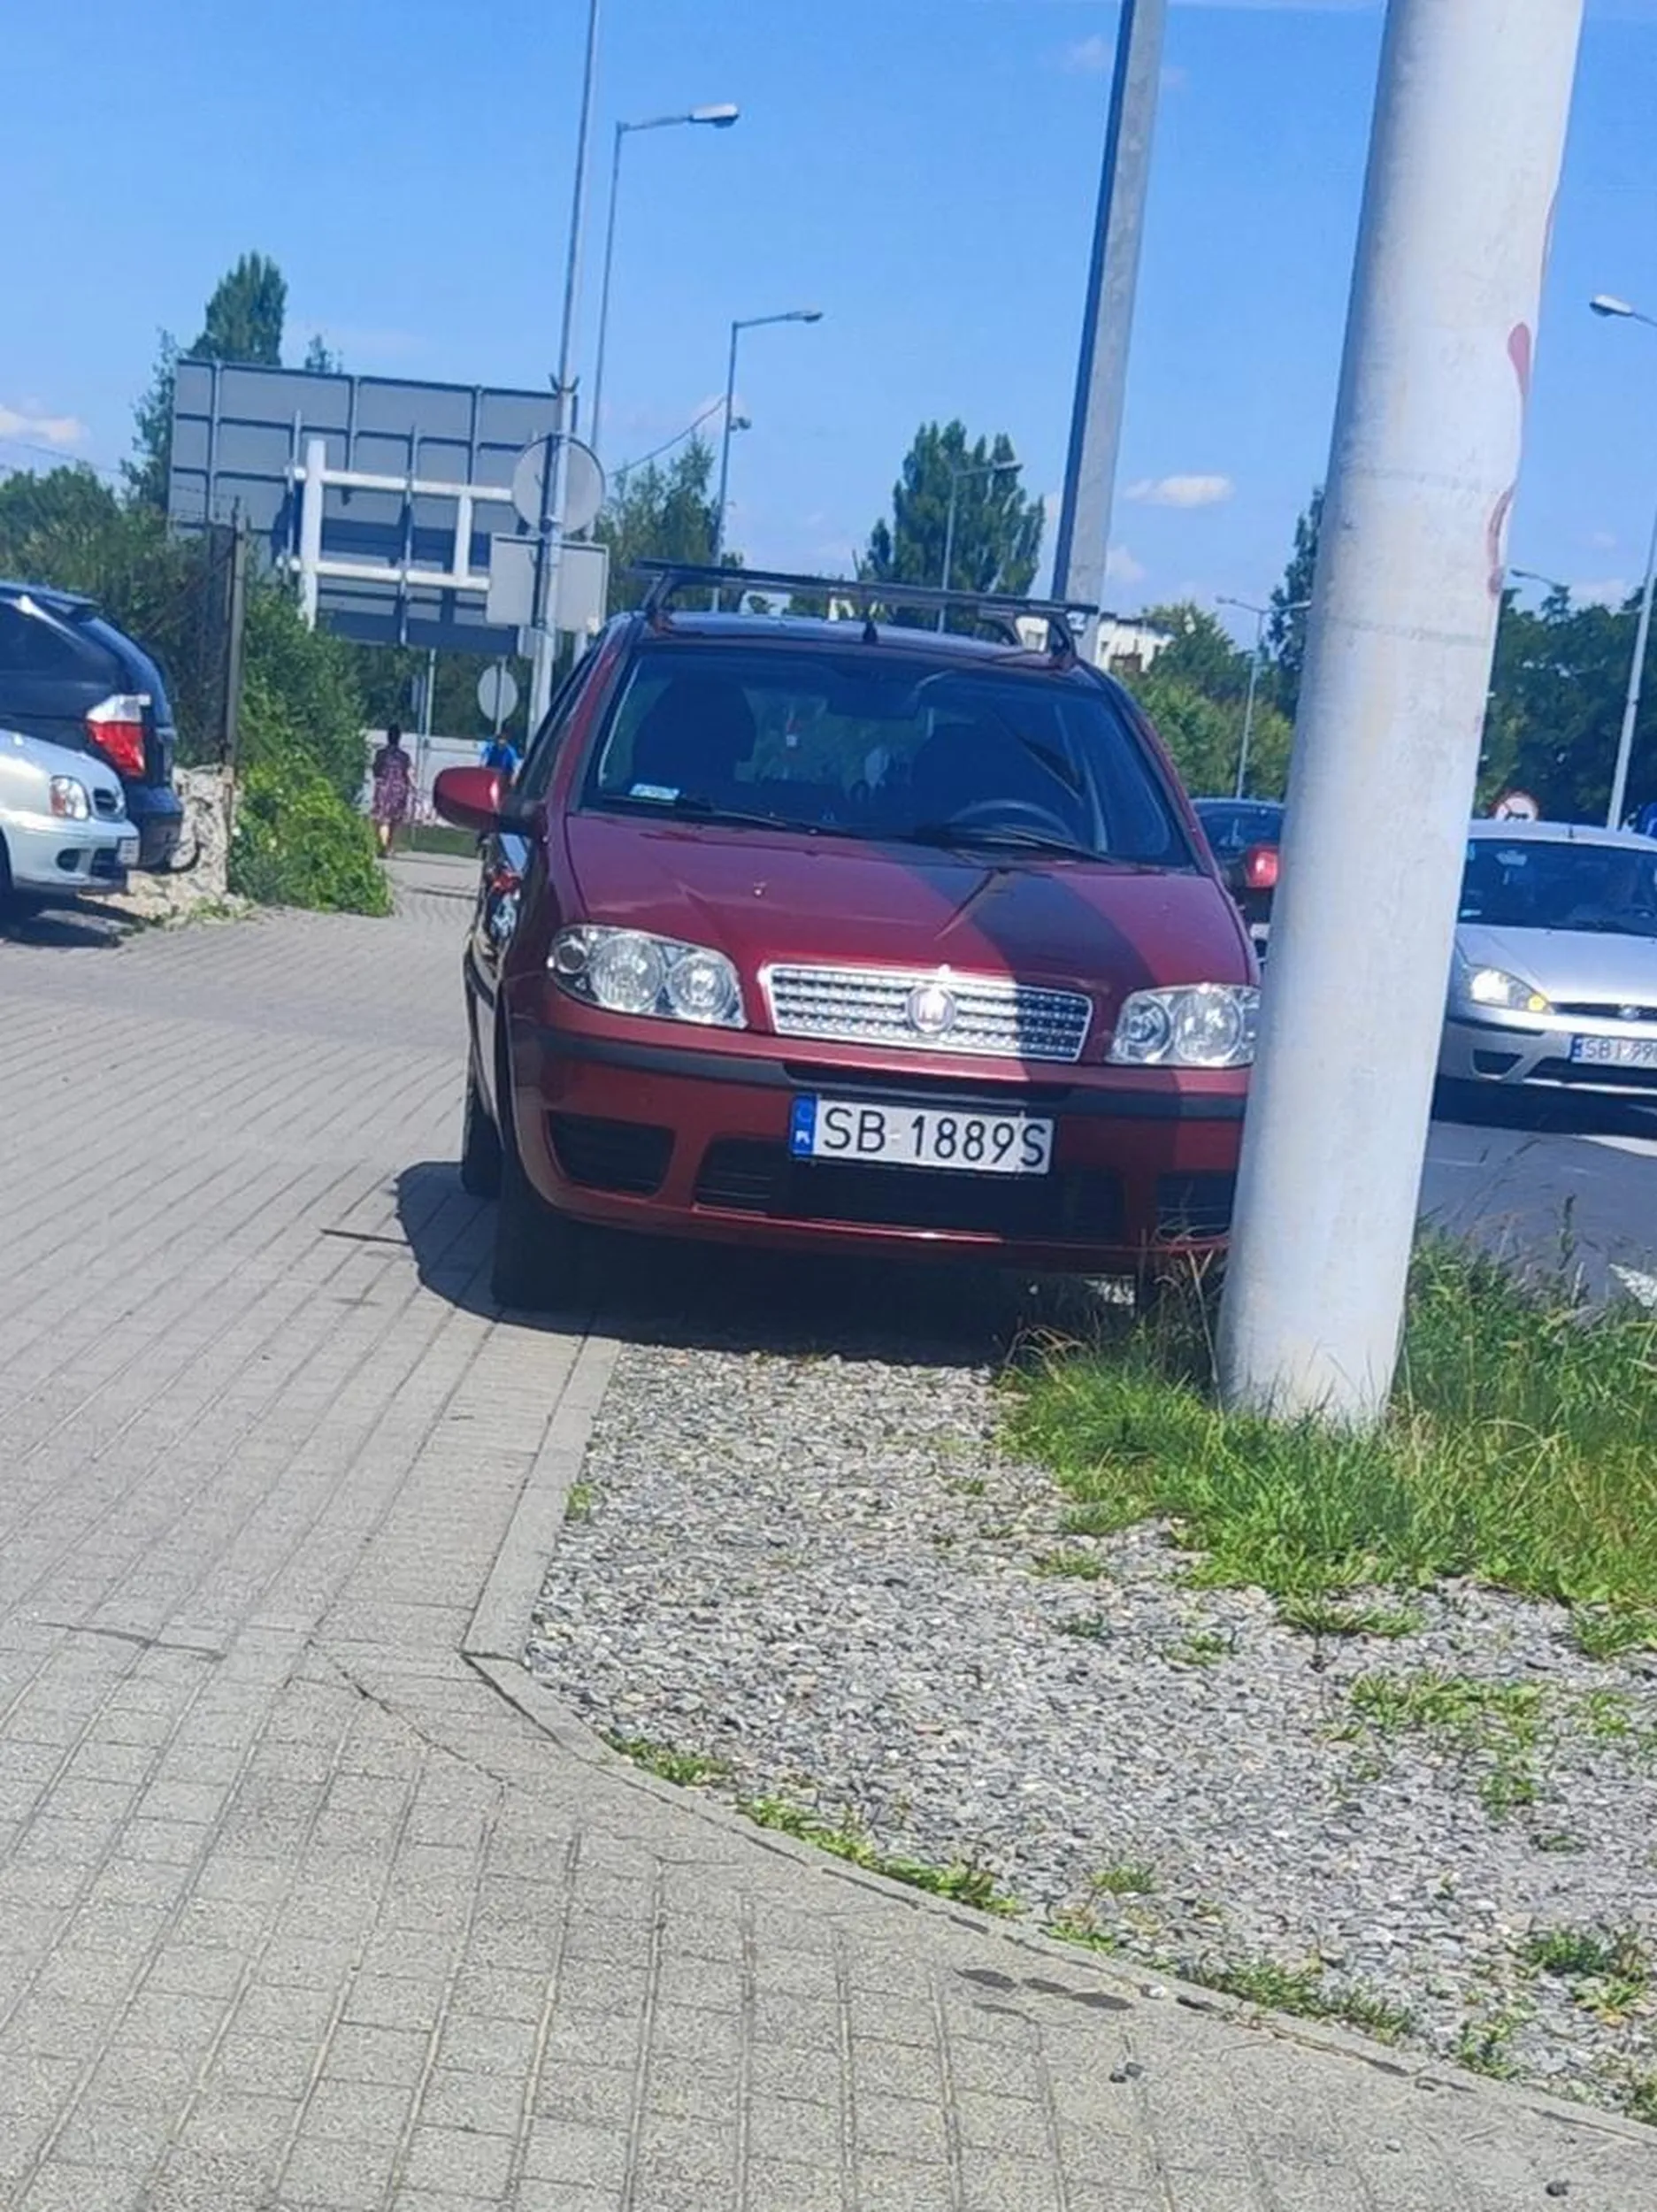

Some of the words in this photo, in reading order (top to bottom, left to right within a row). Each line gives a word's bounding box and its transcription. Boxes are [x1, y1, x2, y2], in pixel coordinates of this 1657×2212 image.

[1630, 1041, 1657, 1062] 99
[824, 1106, 886, 1153] SB
[910, 1114, 1047, 1167] 1889S
